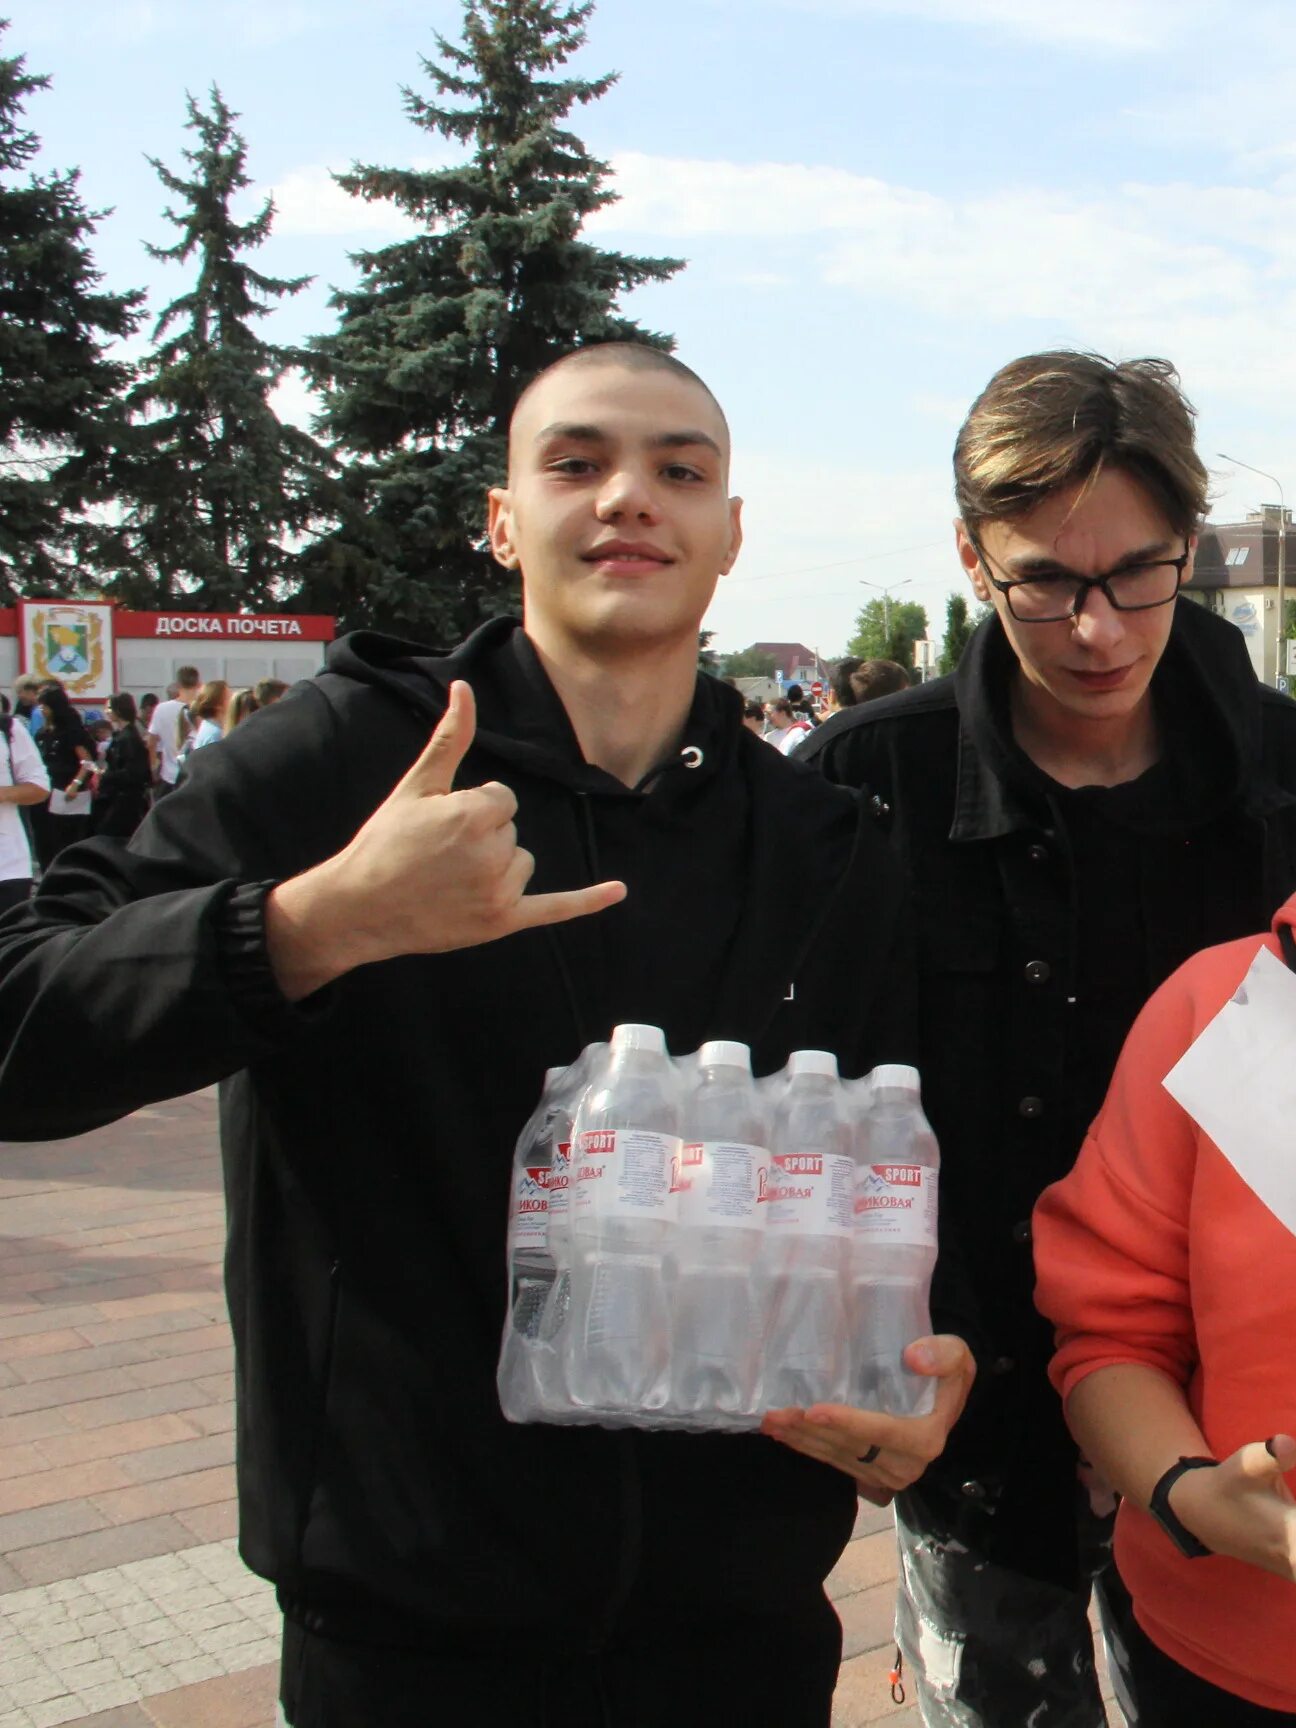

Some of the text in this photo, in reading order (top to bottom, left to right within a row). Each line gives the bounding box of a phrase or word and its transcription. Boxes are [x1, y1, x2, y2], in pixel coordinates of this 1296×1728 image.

[156, 617, 301, 635] ДОСКА ПОЧЕТА
[783, 1157, 823, 1172] SPORT
[885, 1168, 921, 1183] SPORT
